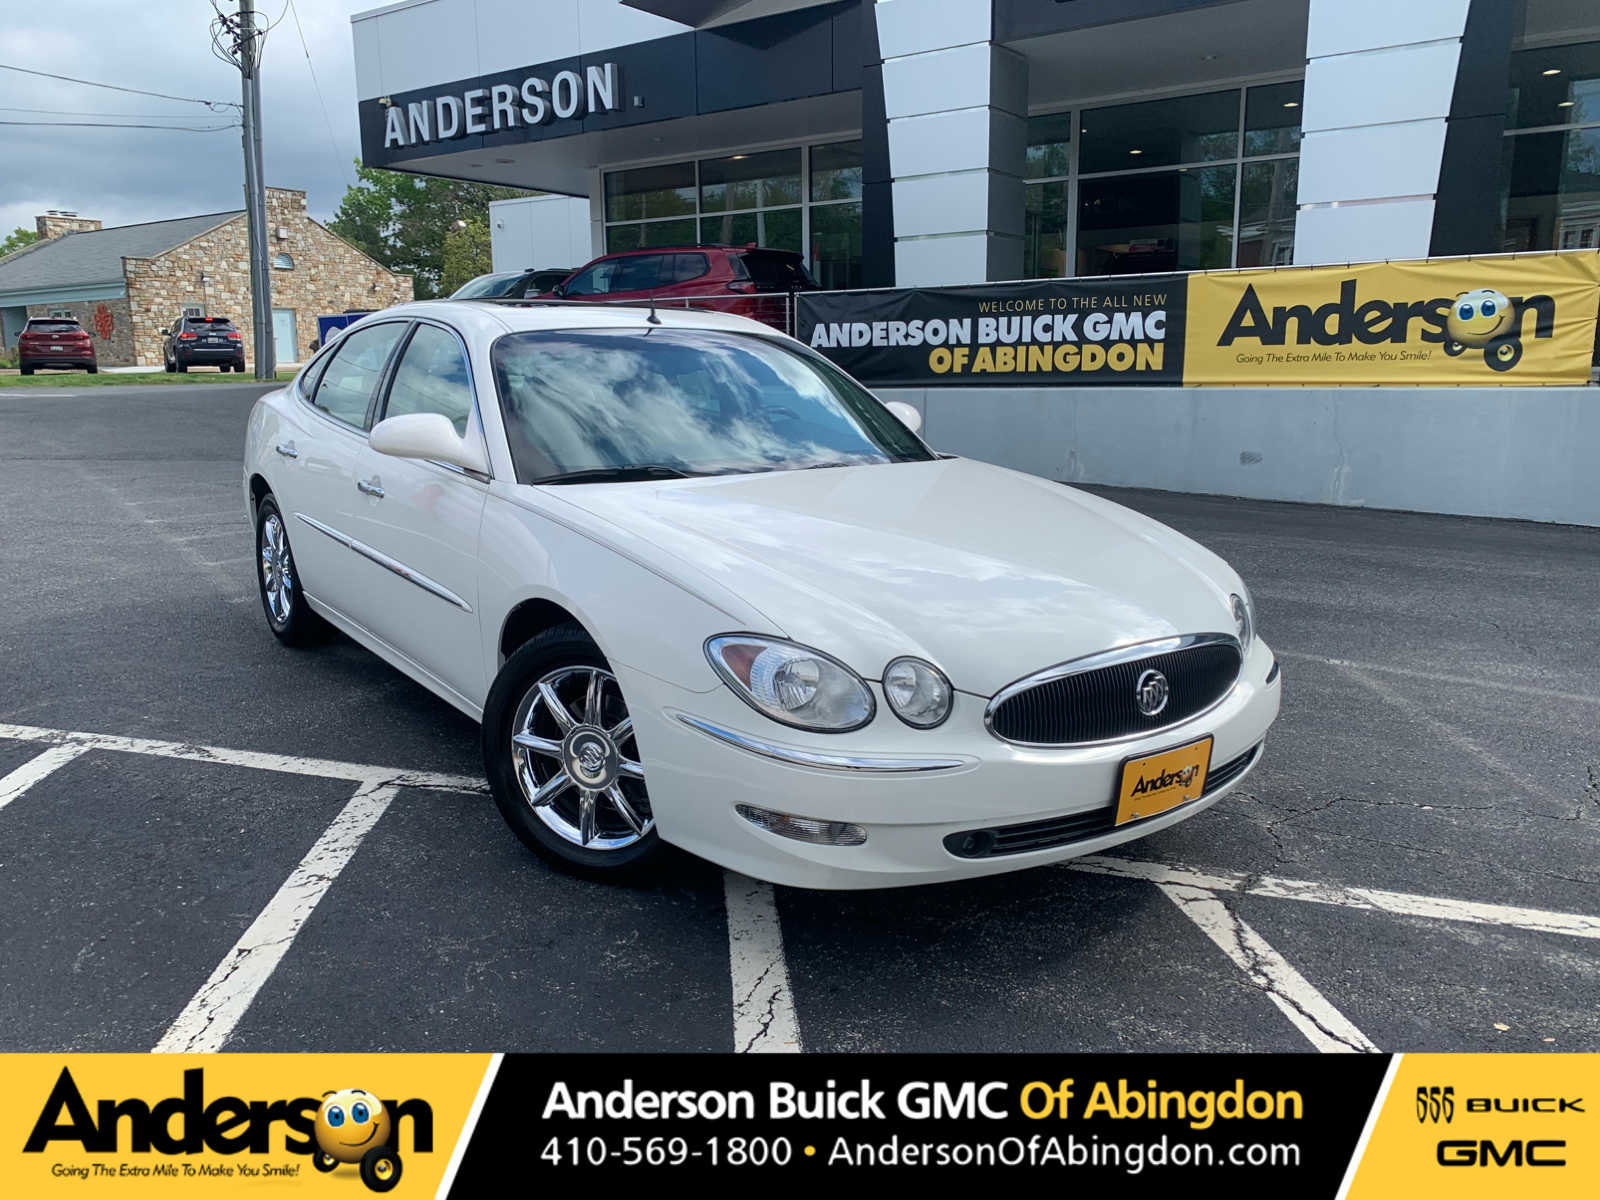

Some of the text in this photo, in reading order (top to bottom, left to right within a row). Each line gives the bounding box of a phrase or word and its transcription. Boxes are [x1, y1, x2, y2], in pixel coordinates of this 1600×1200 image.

[384, 63, 618, 149] ANDERSON
[978, 294, 1167, 313] WELCOME TO THE ALL NEW
[810, 310, 1167, 348] ANDERSON BUICK GMC
[928, 342, 1165, 374] OF ABINGDON
[1235, 350, 1432, 365] Going The Extra Mile To Make You Smile!
